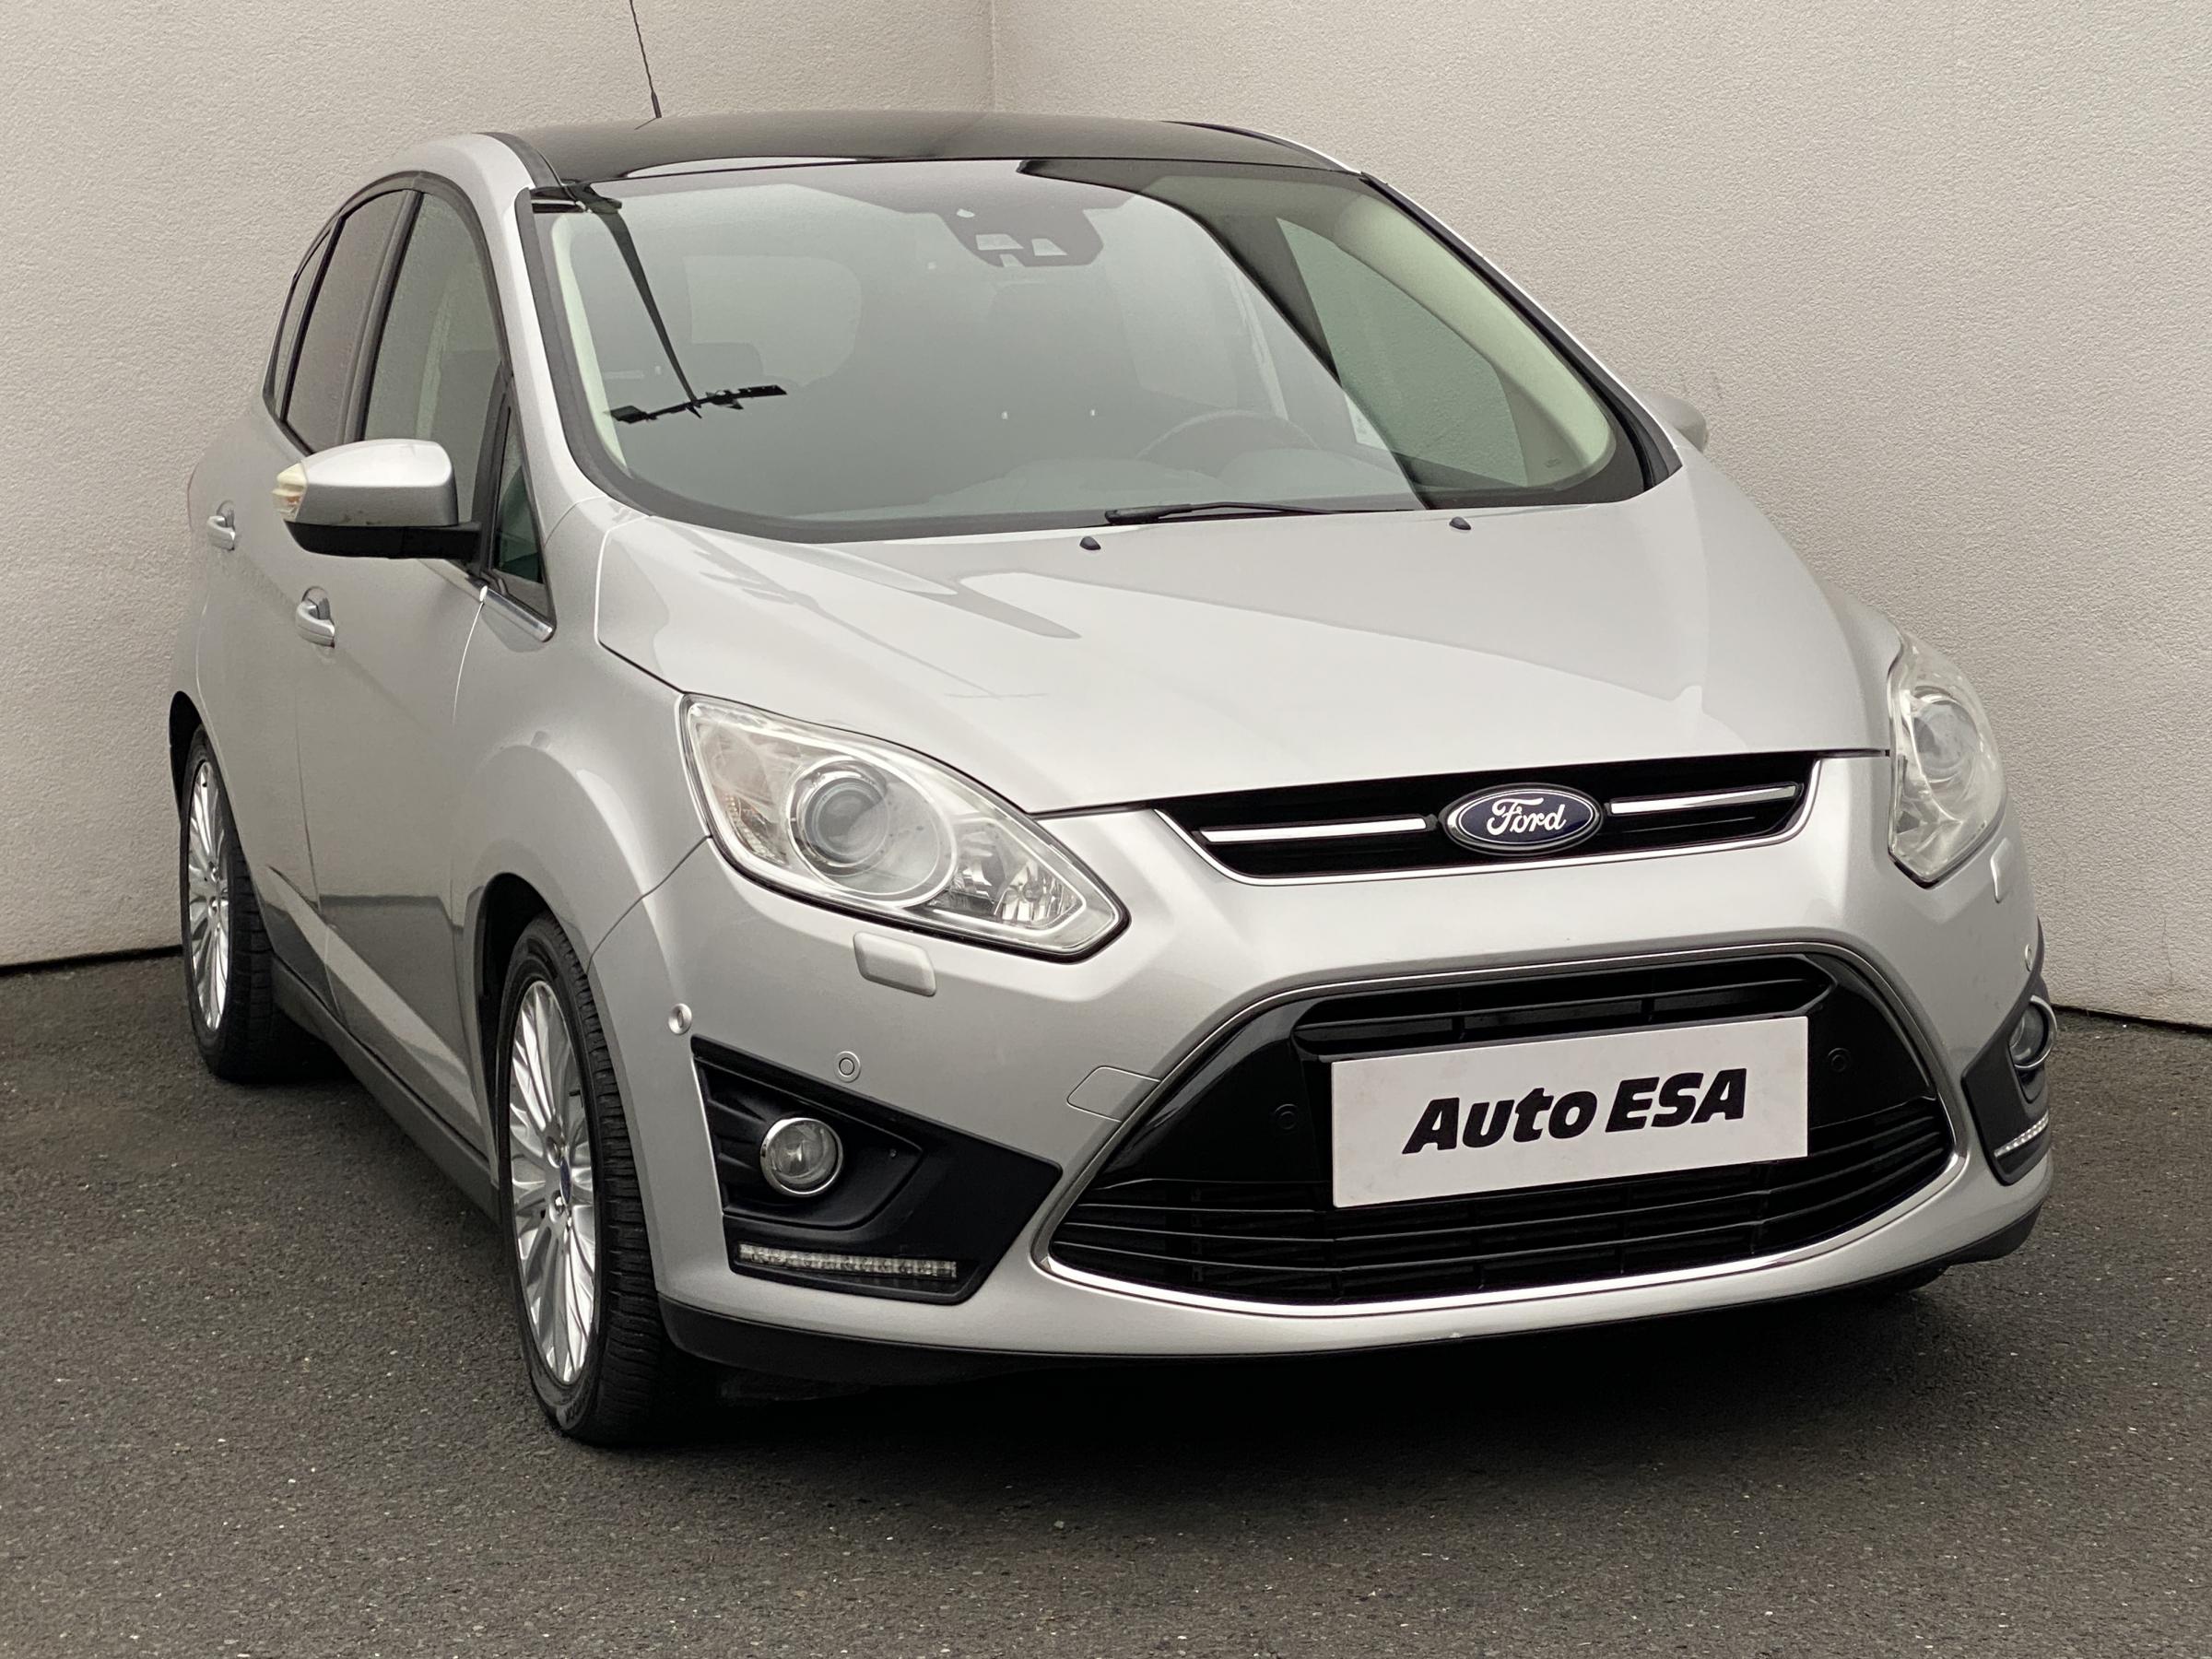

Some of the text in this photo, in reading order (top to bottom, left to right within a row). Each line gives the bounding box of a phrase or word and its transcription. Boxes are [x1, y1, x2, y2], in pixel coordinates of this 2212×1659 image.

[1486, 797, 1567, 836] Ford
[1401, 1067, 1747, 1155] Auto ESA
